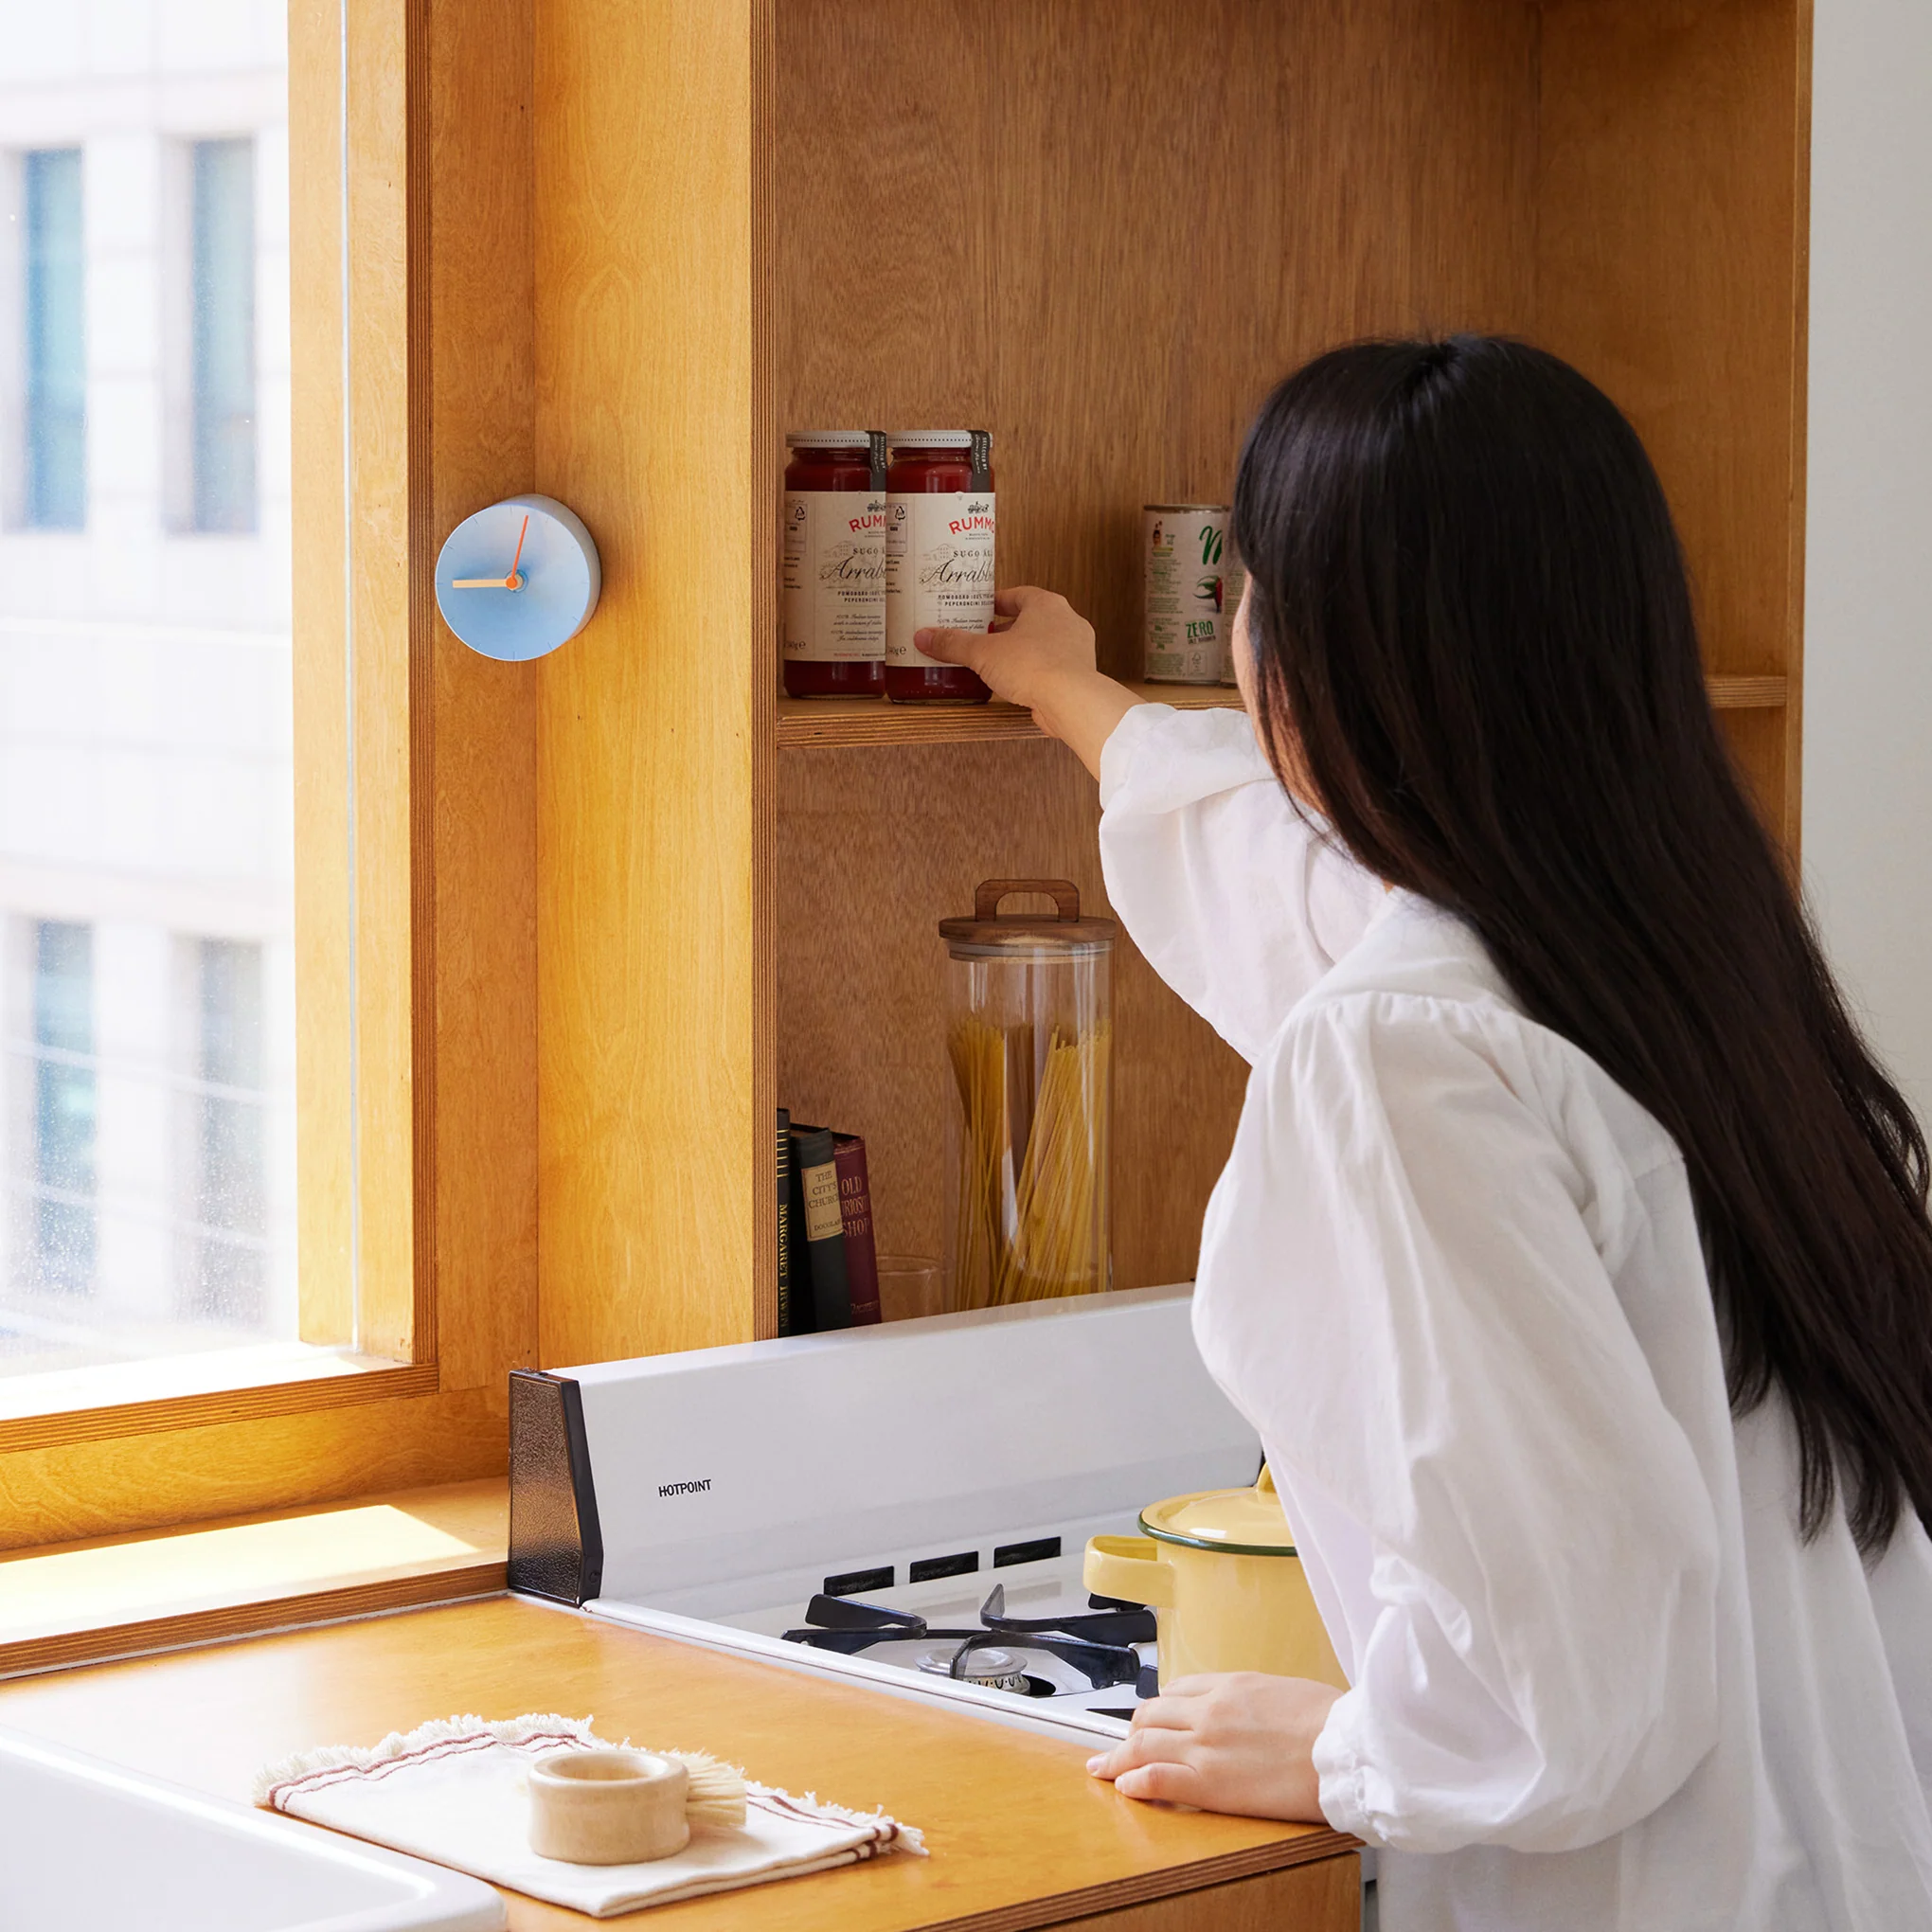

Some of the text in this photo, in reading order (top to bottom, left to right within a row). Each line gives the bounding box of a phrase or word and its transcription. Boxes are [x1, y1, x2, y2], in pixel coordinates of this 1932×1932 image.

[849, 514, 886, 532] RUM
[1185, 620, 1214, 638] ZERO
[815, 1171, 832, 1183] THE
[841, 1176, 862, 1195] OLD
[778, 1204, 789, 1278] MARGARET
[658, 1478, 711, 1497] HOTPOINT
